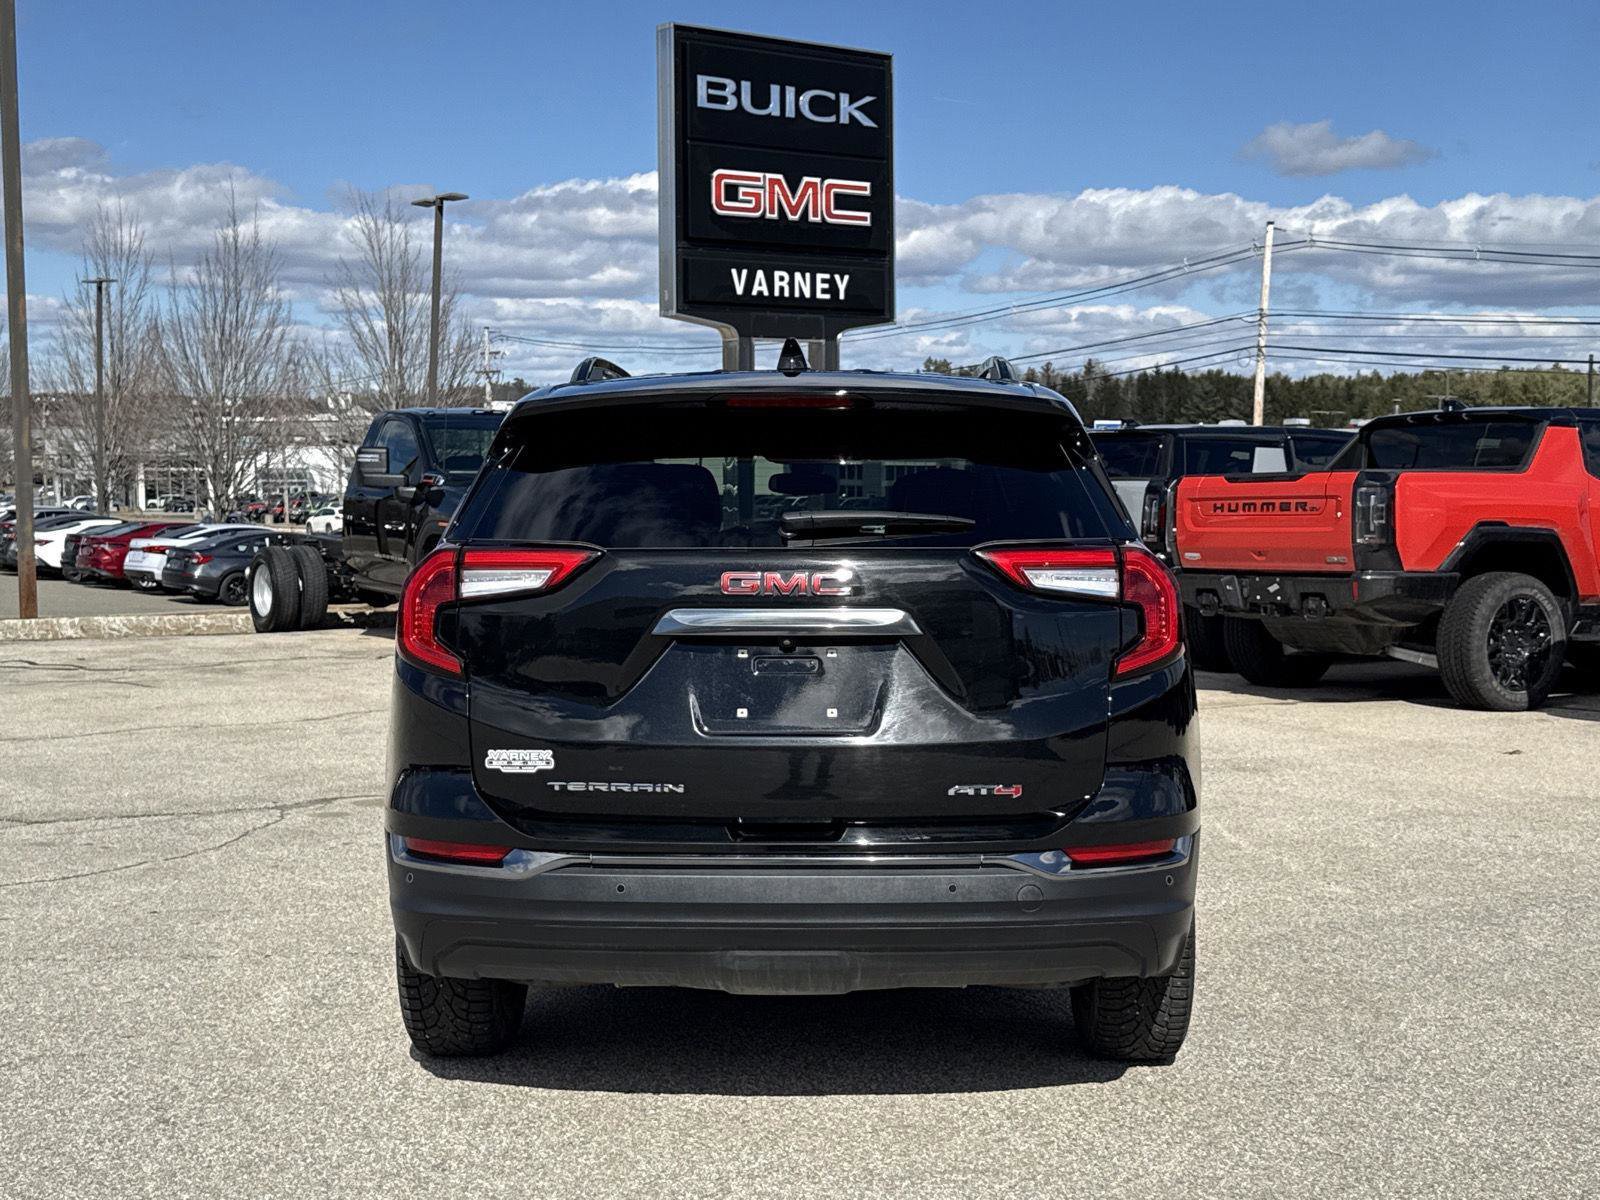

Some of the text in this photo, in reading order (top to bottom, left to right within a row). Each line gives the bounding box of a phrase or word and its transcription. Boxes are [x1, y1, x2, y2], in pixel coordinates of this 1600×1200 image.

[696, 74, 878, 129] BUICK
[711, 168, 872, 227] GMC
[730, 268, 850, 301] VARNEY
[1213, 501, 1308, 512] HUMMER
[720, 571, 853, 596] GMC
[488, 750, 552, 761] VARNEY
[546, 781, 685, 794] TERRAIN
[947, 784, 1023, 799] AT4
